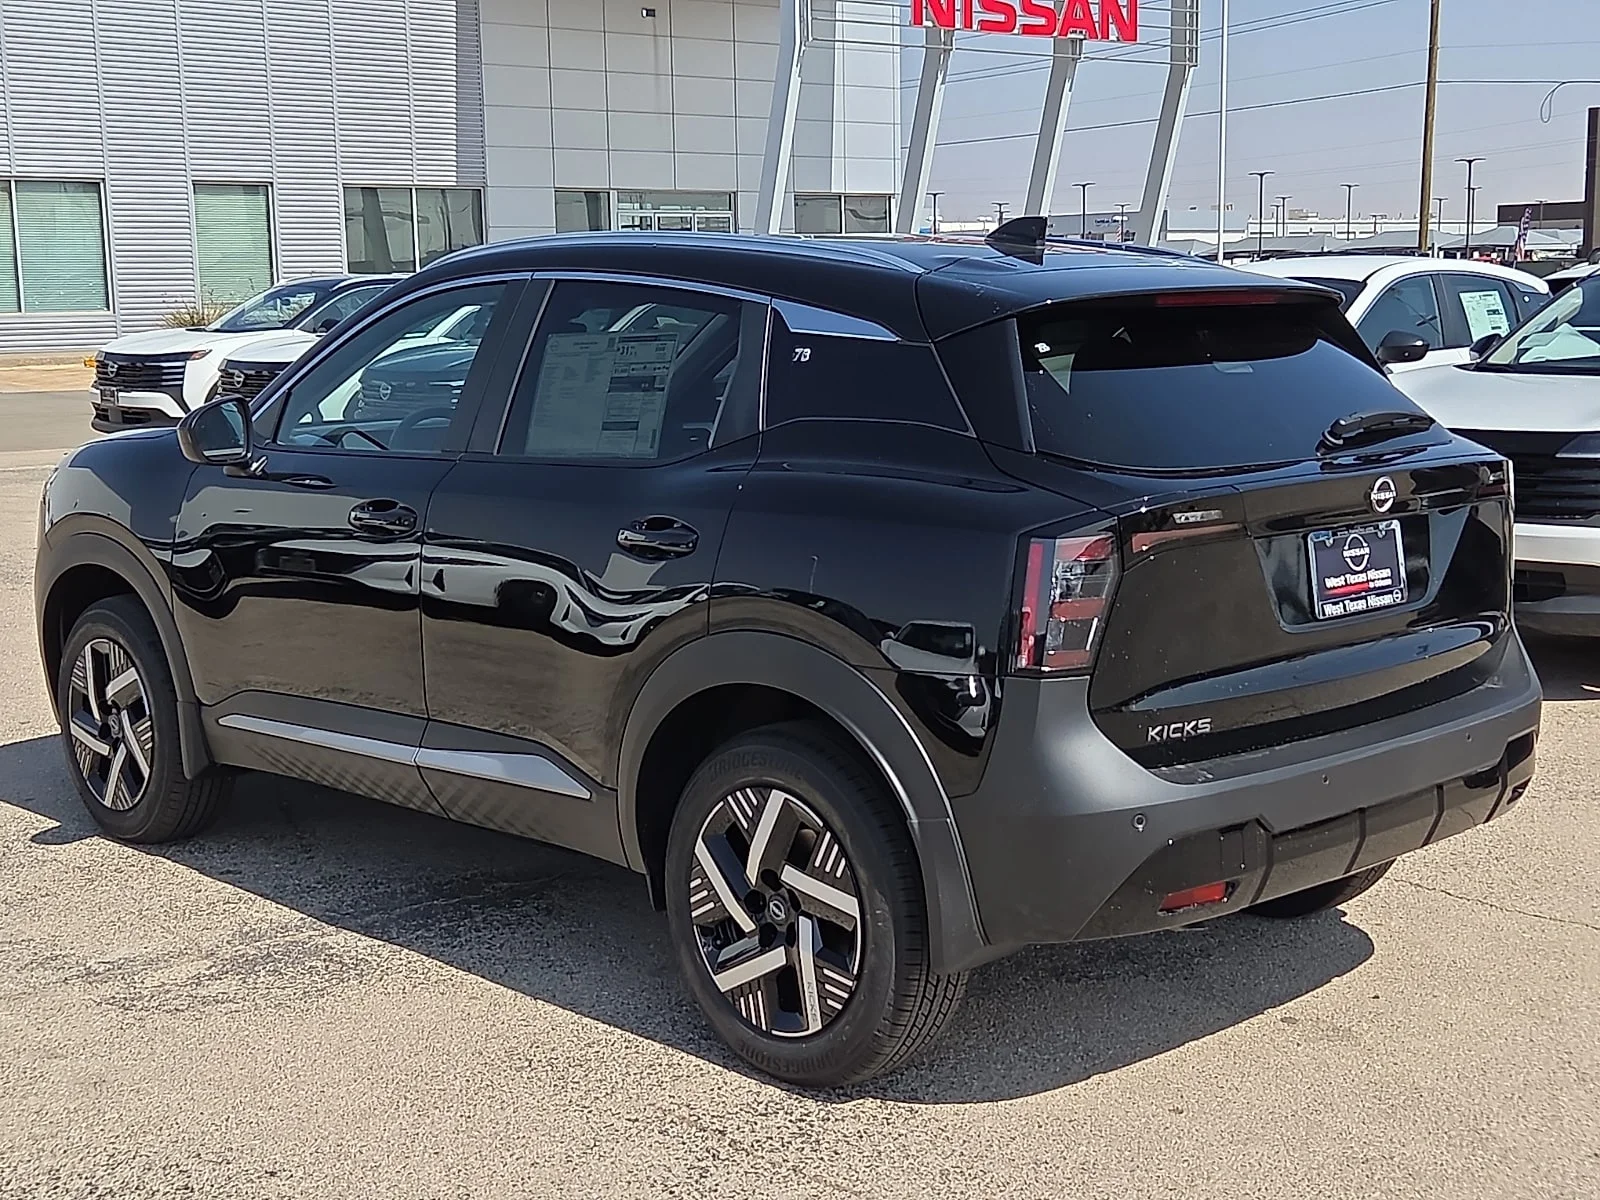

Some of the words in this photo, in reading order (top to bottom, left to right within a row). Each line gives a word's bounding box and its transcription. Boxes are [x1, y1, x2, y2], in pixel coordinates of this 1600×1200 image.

[910, 0, 1138, 42] NISSAN
[1343, 547, 1370, 557] NISSAN
[1324, 575, 1345, 589] West
[1346, 572, 1367, 585] Texas
[1367, 568, 1392, 580] Nissan
[1323, 603, 1344, 617] West
[1344, 599, 1367, 613] Texas
[1367, 594, 1393, 608] Nissan
[1147, 717, 1213, 742] KICKS
